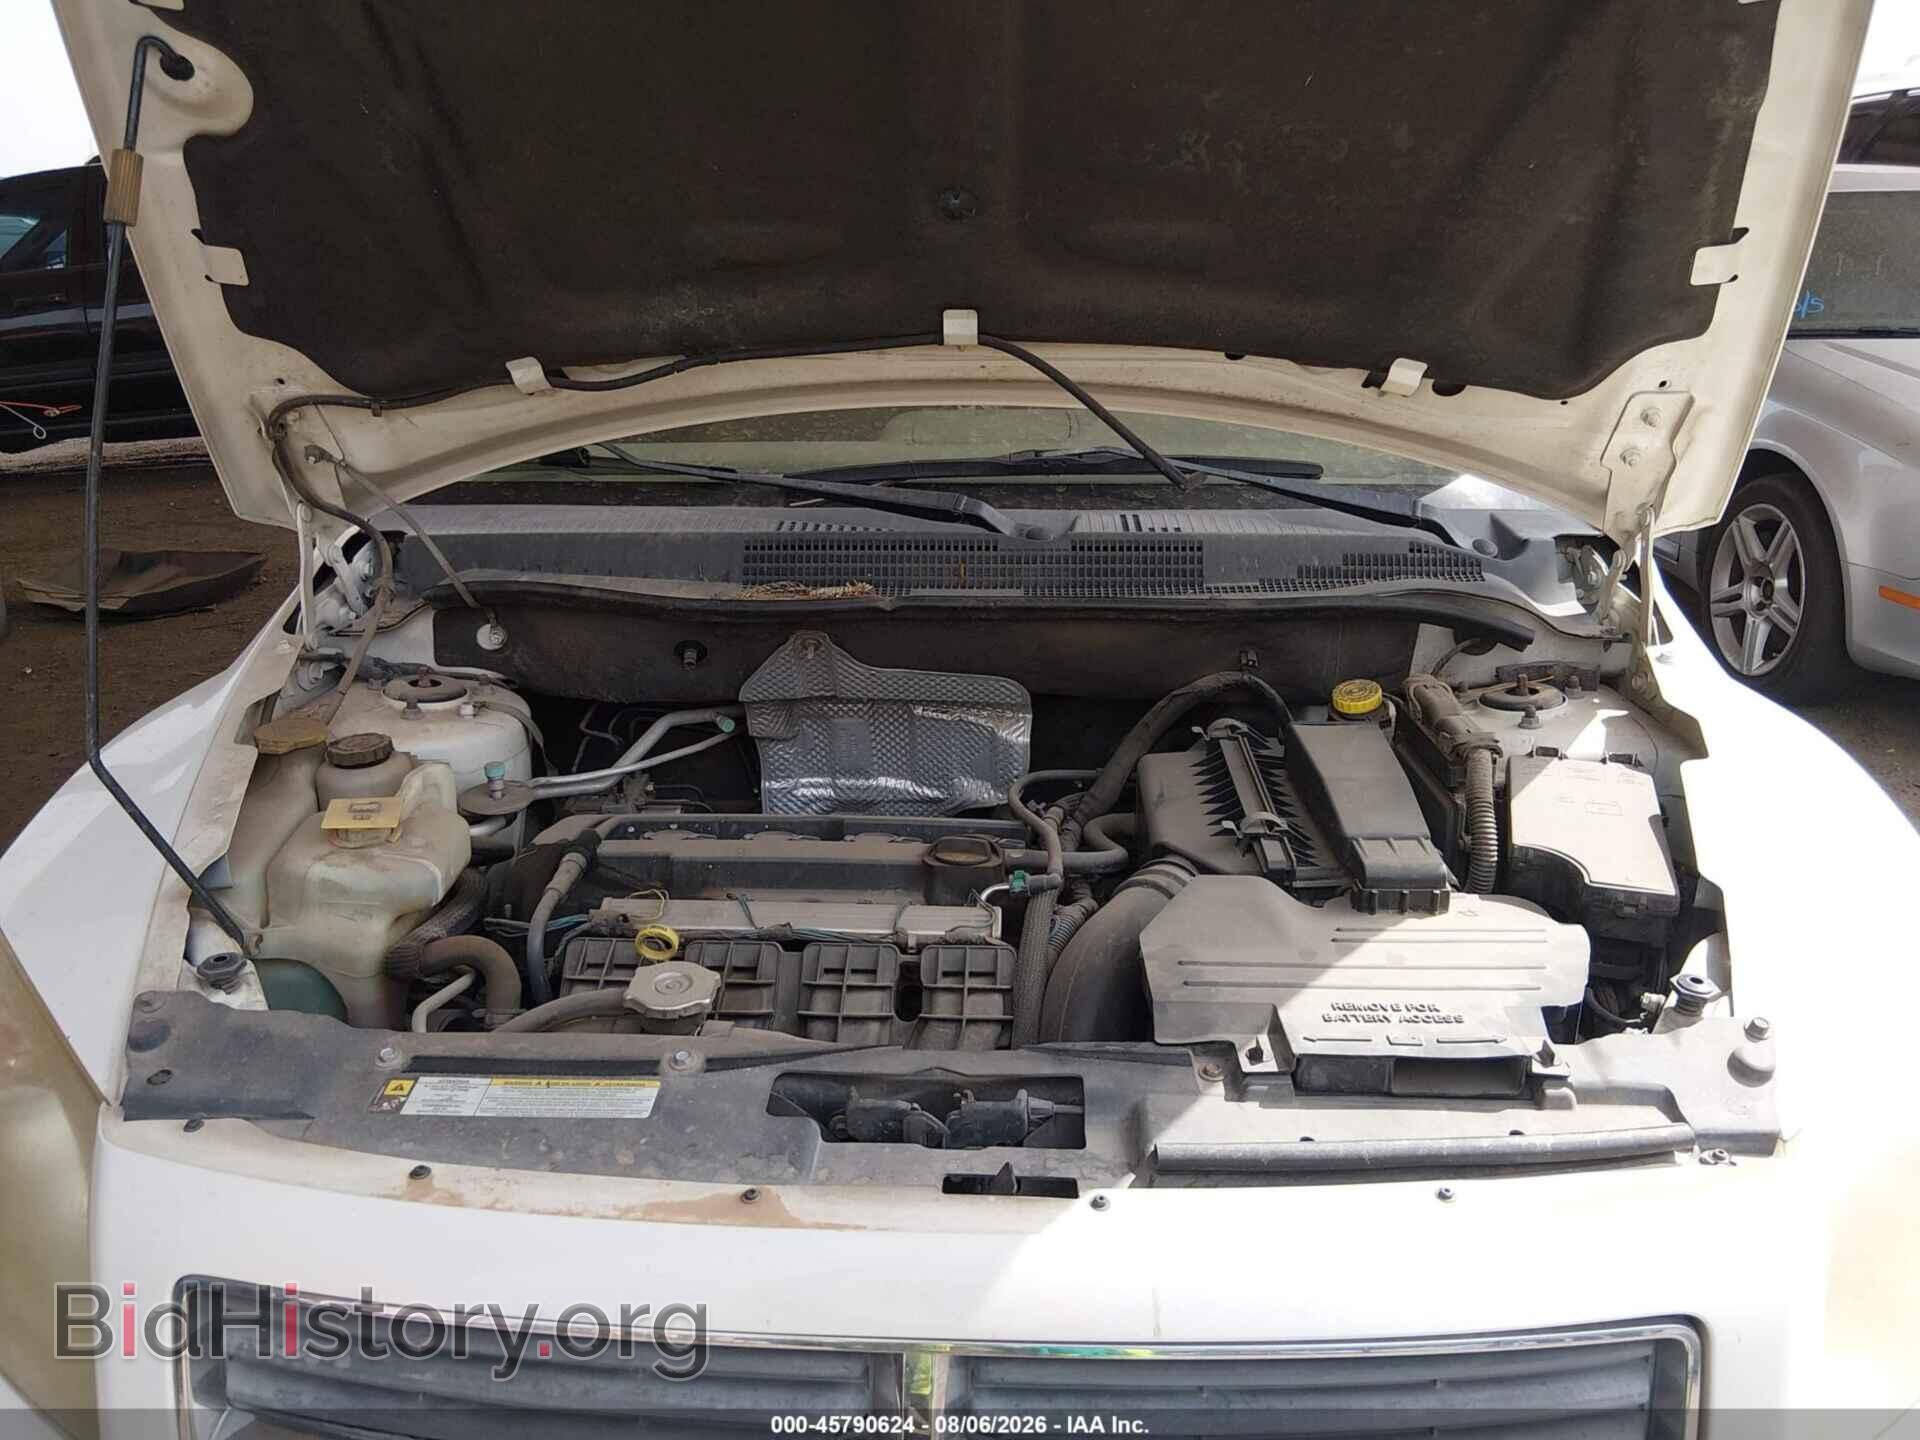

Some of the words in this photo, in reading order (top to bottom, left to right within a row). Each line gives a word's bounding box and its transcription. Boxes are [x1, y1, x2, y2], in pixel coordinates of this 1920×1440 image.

[1330, 1002, 1402, 1012] REMOVE
[1405, 1003, 1440, 1013] FOR
[1321, 1013, 1391, 1023] BATTERY
[1399, 1014, 1465, 1024] ACCESS
